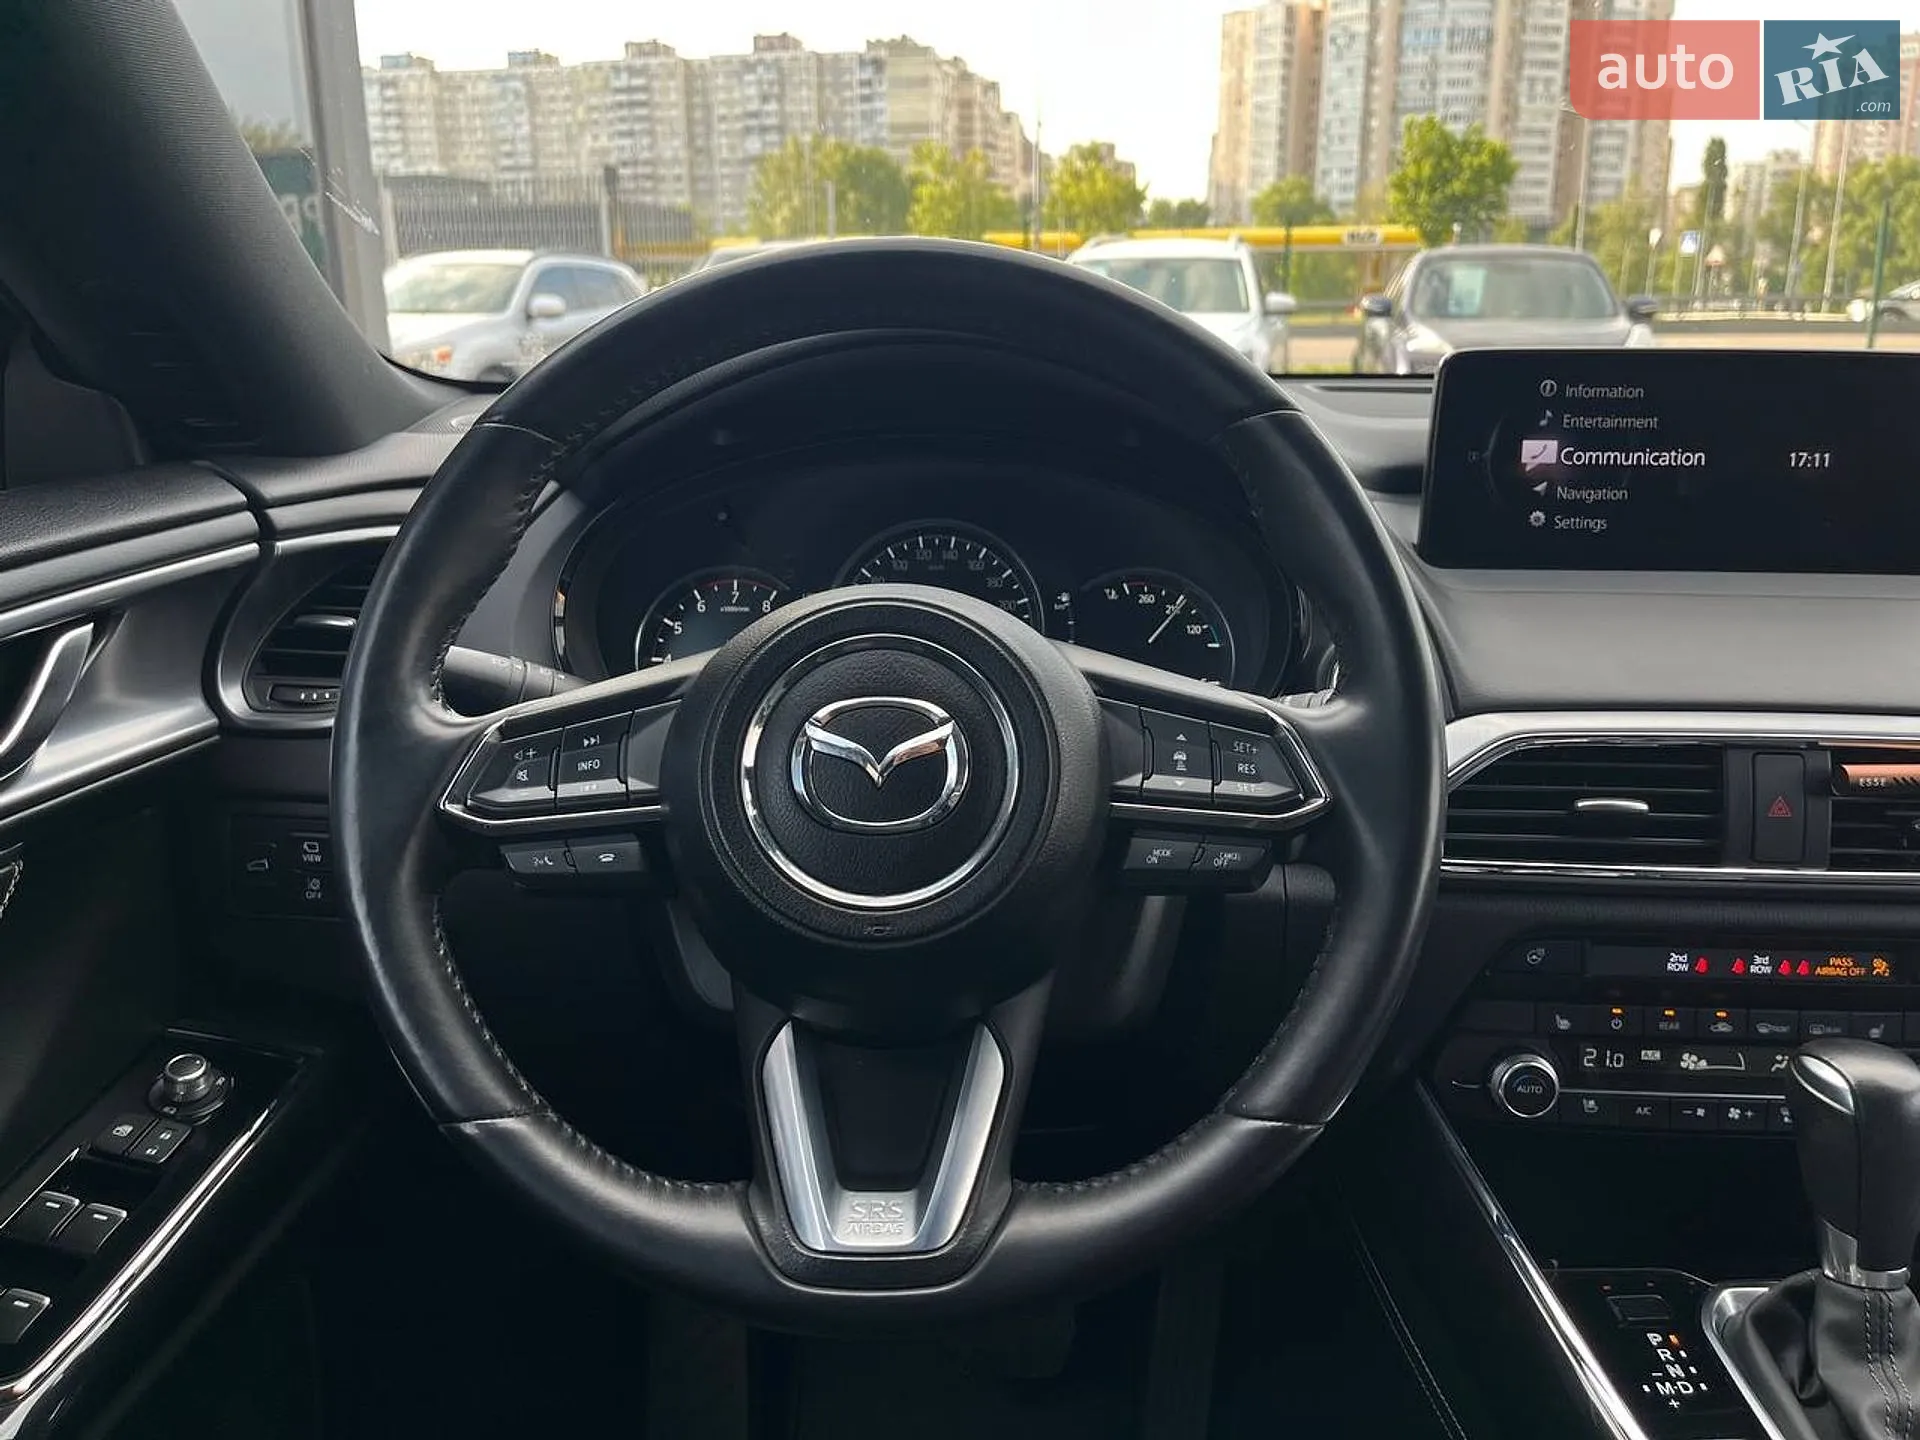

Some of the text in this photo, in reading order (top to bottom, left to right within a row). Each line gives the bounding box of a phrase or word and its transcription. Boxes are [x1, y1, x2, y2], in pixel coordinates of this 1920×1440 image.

[1565, 383, 1644, 400] Information
[1562, 413, 1659, 430] Entertainment
[1560, 446, 1706, 467] Communication
[1788, 451, 1831, 469] 17:11
[1556, 485, 1629, 503] Navigation
[1554, 515, 1608, 531] Settings
[731, 591, 740, 604] 7
[1138, 594, 1155, 605] 260
[697, 600, 706, 613] 6
[762, 600, 771, 613] 8
[673, 621, 682, 635] 5
[1186, 625, 1201, 635] 120
[577, 759, 601, 771] INFO
[1237, 763, 1257, 775] RES
[302, 853, 322, 863] VIEW
[1146, 854, 1159, 864] ON
[1669, 953, 1688, 962] 2nd
[1753, 955, 1770, 964] 3rd
[1830, 957, 1853, 967] PASS
[1667, 962, 1689, 972] ROW
[1750, 964, 1772, 974] ROW
[1815, 967, 1867, 977] AIRBAG OFF
[1516, 1084, 1543, 1094] AUTO
[1635, 1106, 1652, 1115] A/C
[850, 1199, 904, 1219] SRS
[844, 1221, 904, 1234] AIRBAG
[1646, 1332, 1662, 1346] P
[1656, 1348, 1675, 1361] R
[1665, 1363, 1685, 1378] N
